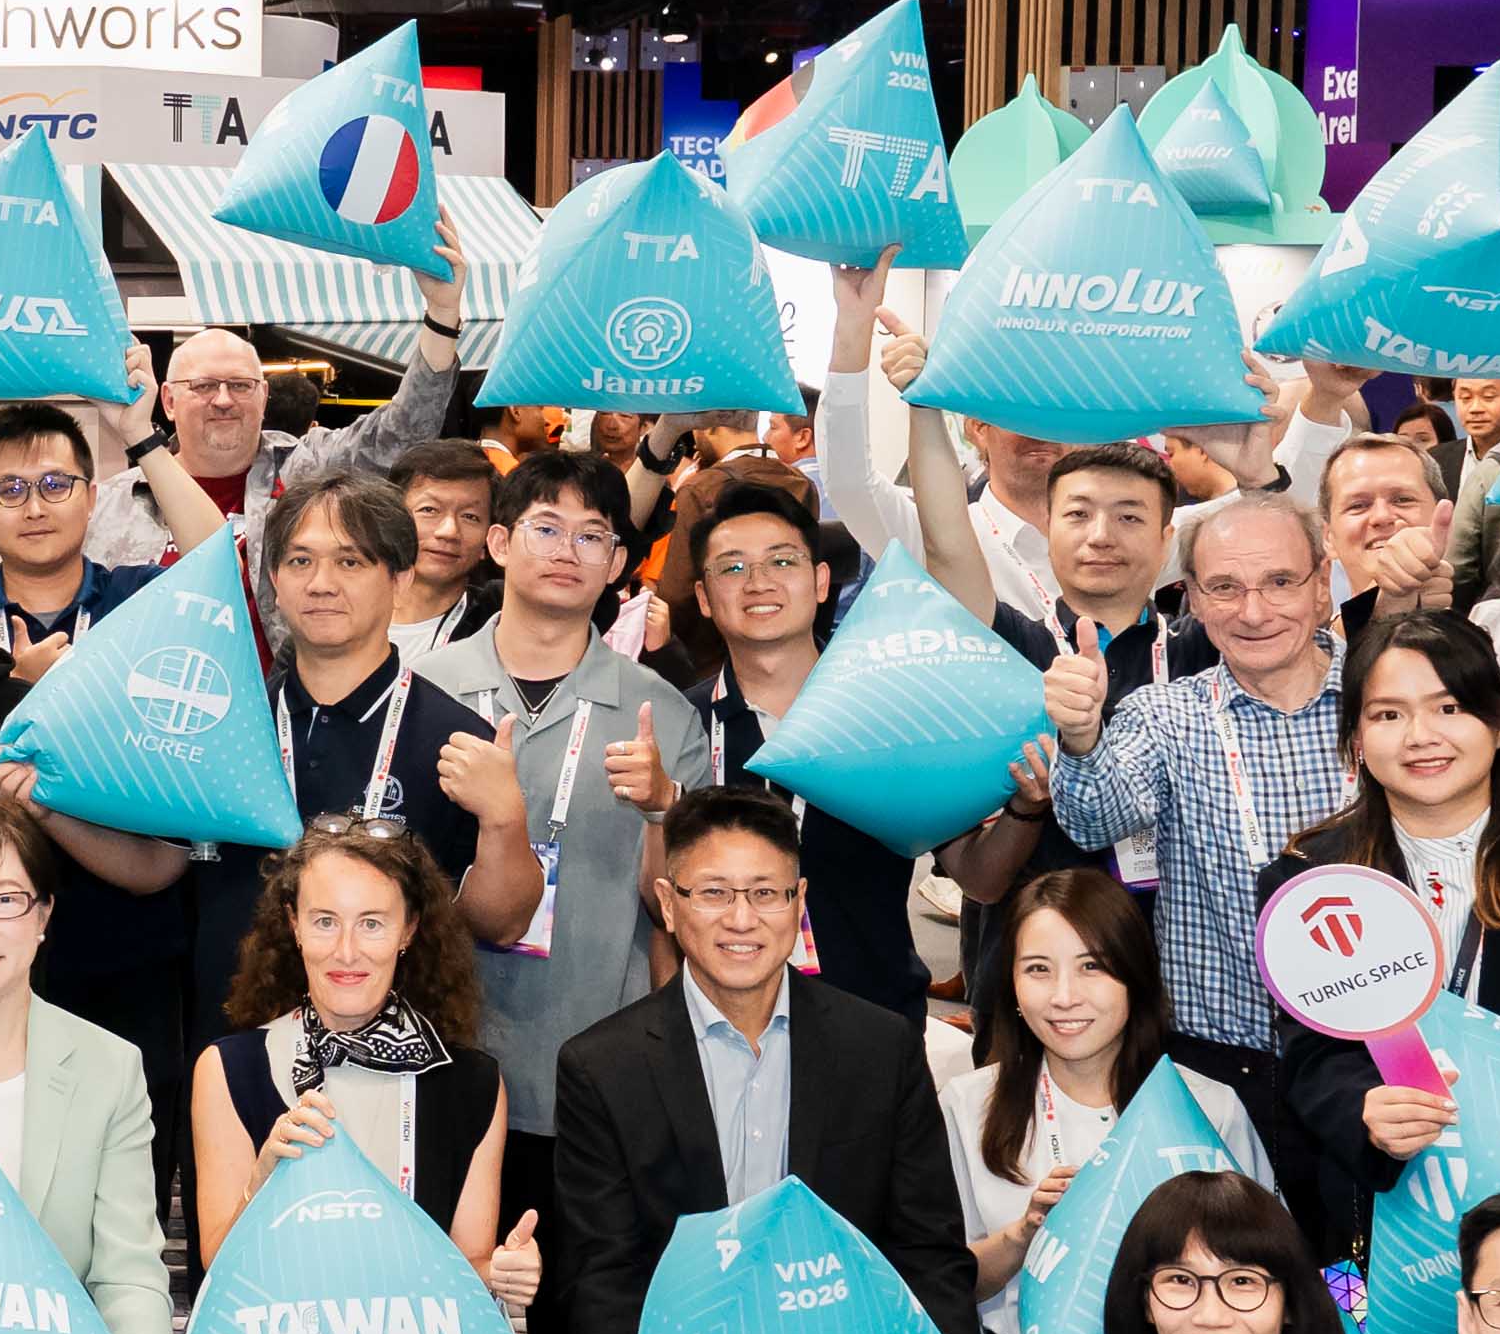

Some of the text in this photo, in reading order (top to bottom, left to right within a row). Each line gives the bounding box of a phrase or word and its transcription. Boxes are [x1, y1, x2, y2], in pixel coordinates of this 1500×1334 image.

[371, 72, 419, 108] TTA
[1323, 66, 1357, 102] Exe
[163, 92, 249, 146] TTA
[1190, 107, 1223, 122] TTA
[828, 125, 949, 205] TTA
[1074, 177, 1160, 208] TTA
[623, 230, 699, 262] TTA
[996, 315, 1191, 340] INNOLUX CORPORATION
[581, 367, 706, 396] Janus
[871, 577, 944, 600] TTA
[173, 591, 236, 635] TTA
[122, 728, 206, 764] NCREE
[1299, 950, 1429, 1009] TURING SPACE
[295, 1201, 384, 1223] NSTC
[774, 1251, 843, 1284] VIVA
[778, 1280, 849, 1312] 2026
